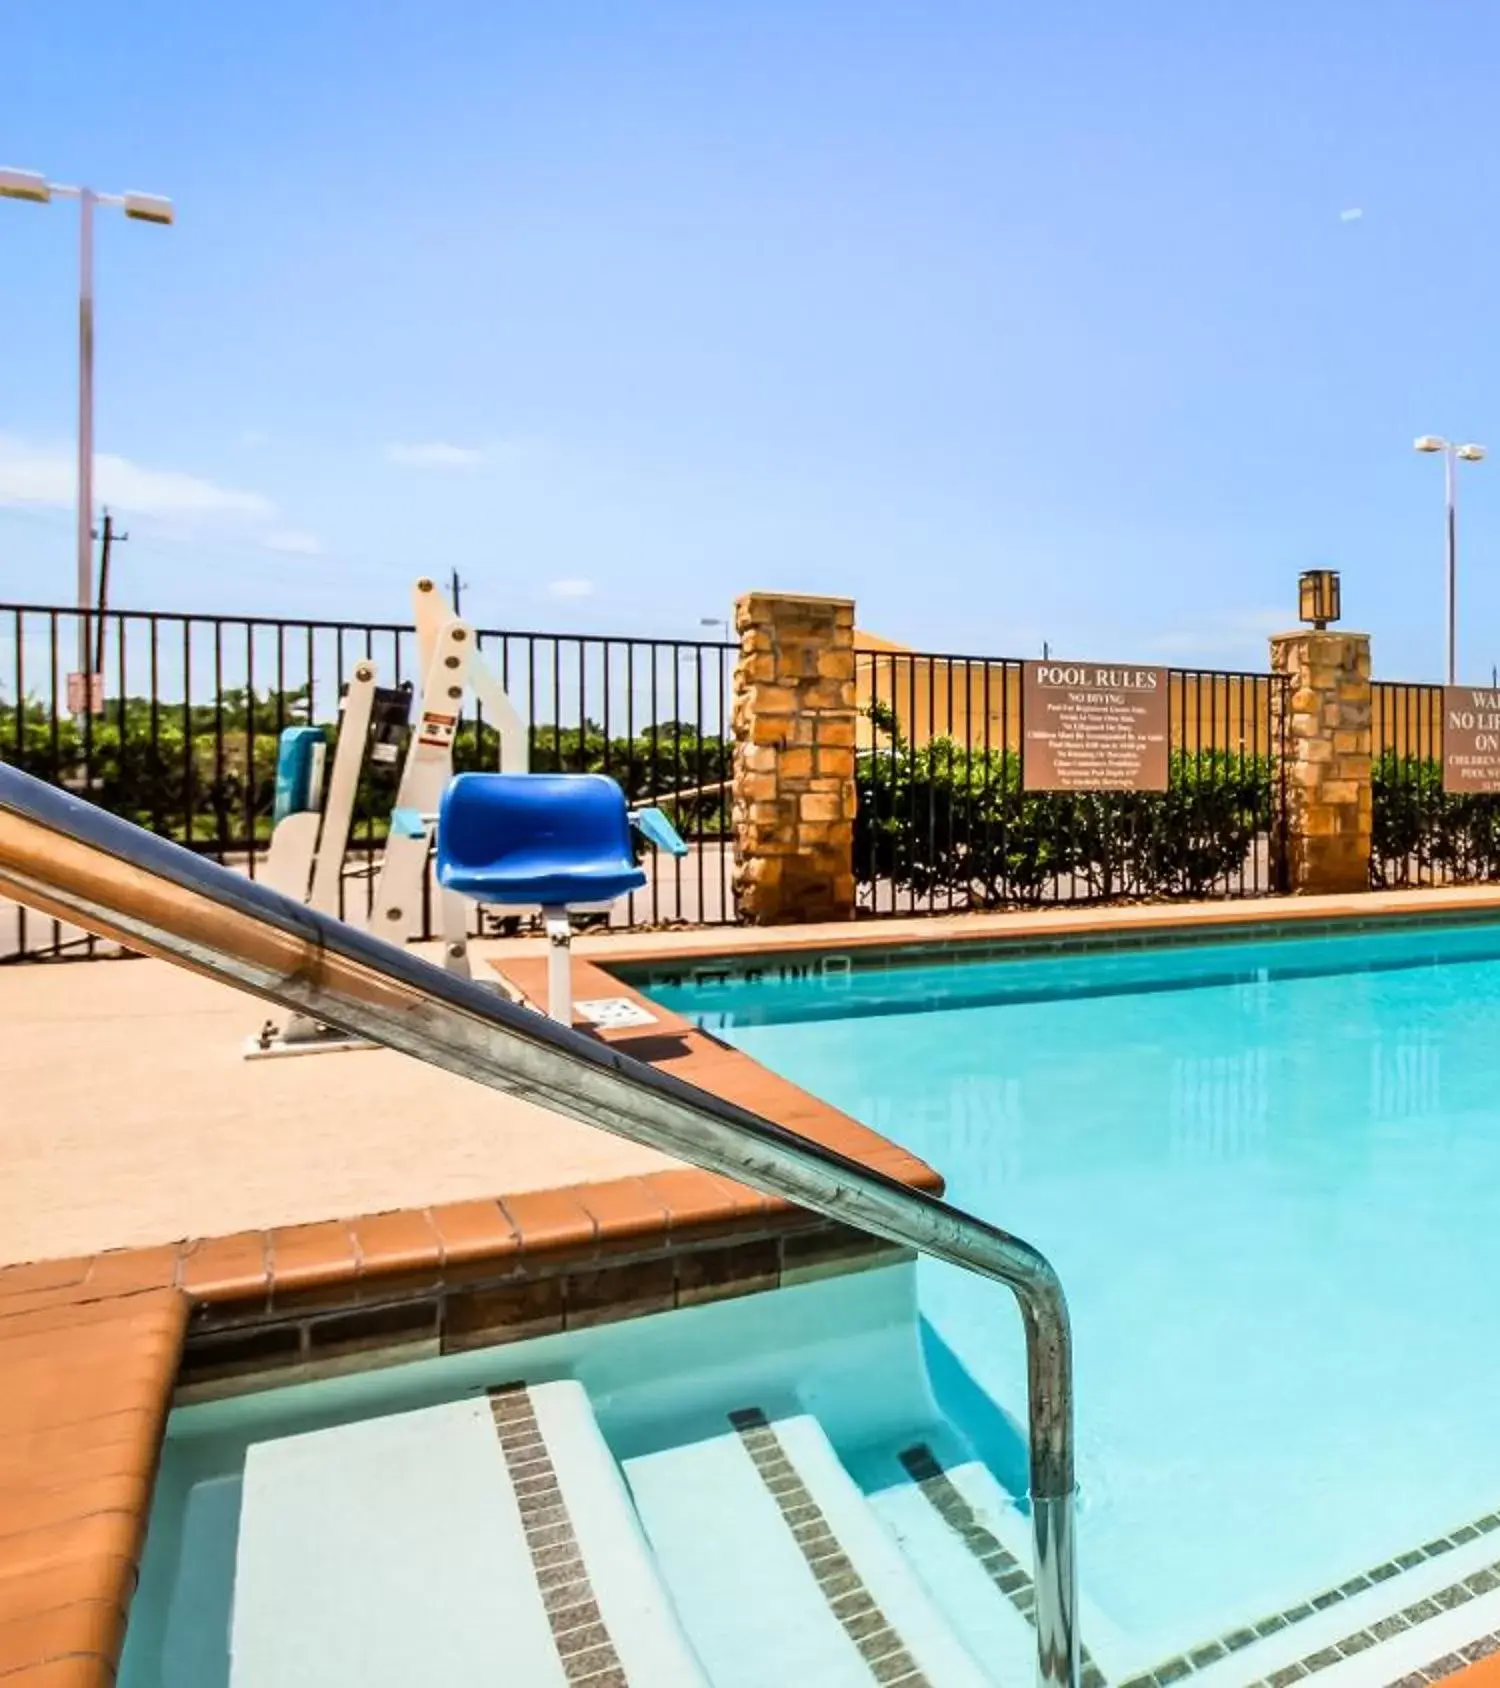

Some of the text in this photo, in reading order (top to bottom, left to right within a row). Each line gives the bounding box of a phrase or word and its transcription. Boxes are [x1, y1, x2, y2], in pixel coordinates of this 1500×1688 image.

[1037, 667, 1157, 689] POOL RULES
[1067, 693, 1125, 705] NO DIVING
[1449, 711, 1474, 730] NO
[1475, 734, 1498, 752] ON
